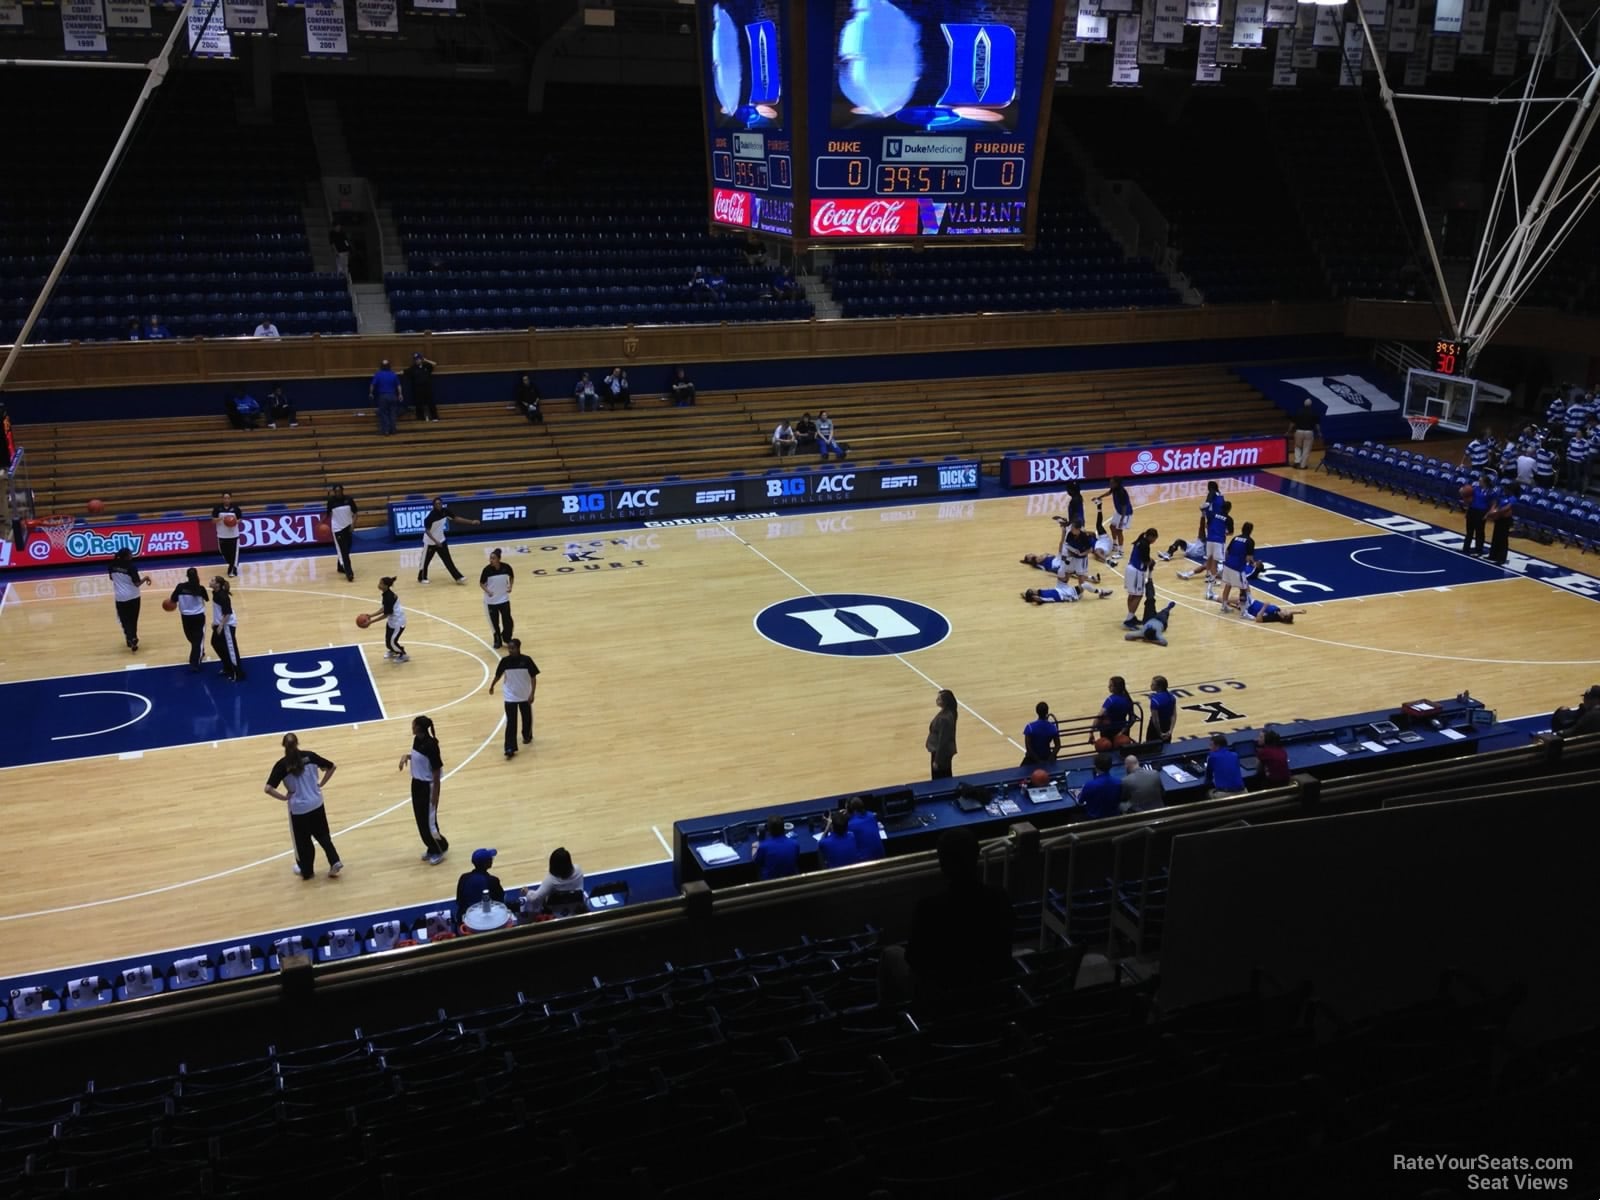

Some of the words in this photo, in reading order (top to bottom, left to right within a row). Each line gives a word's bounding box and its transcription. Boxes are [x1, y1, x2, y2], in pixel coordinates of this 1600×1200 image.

[827, 141, 862, 154] DUKE
[973, 143, 1026, 155] PURDUE
[848, 160, 862, 186] 0
[1001, 161, 1015, 186] 0
[946, 202, 1027, 223] VALEANT
[1438, 354, 1455, 375] 30
[940, 469, 977, 486] DICK'S
[1028, 455, 1090, 484] BB&T
[816, 473, 856, 493] ACC
[881, 475, 919, 489] ESPN
[616, 489, 661, 510] ACC
[695, 489, 737, 504] ESPN
[481, 505, 527, 522] ESPN
[569, 508, 656, 522] CHALLENGE
[67, 530, 143, 558] O'Reilly
[149, 531, 185, 543] AUTO
[147, 542, 191, 554] PARTS
[533, 559, 645, 576] COURT
[272, 660, 347, 713] ACC
[1181, 701, 1248, 724] K
